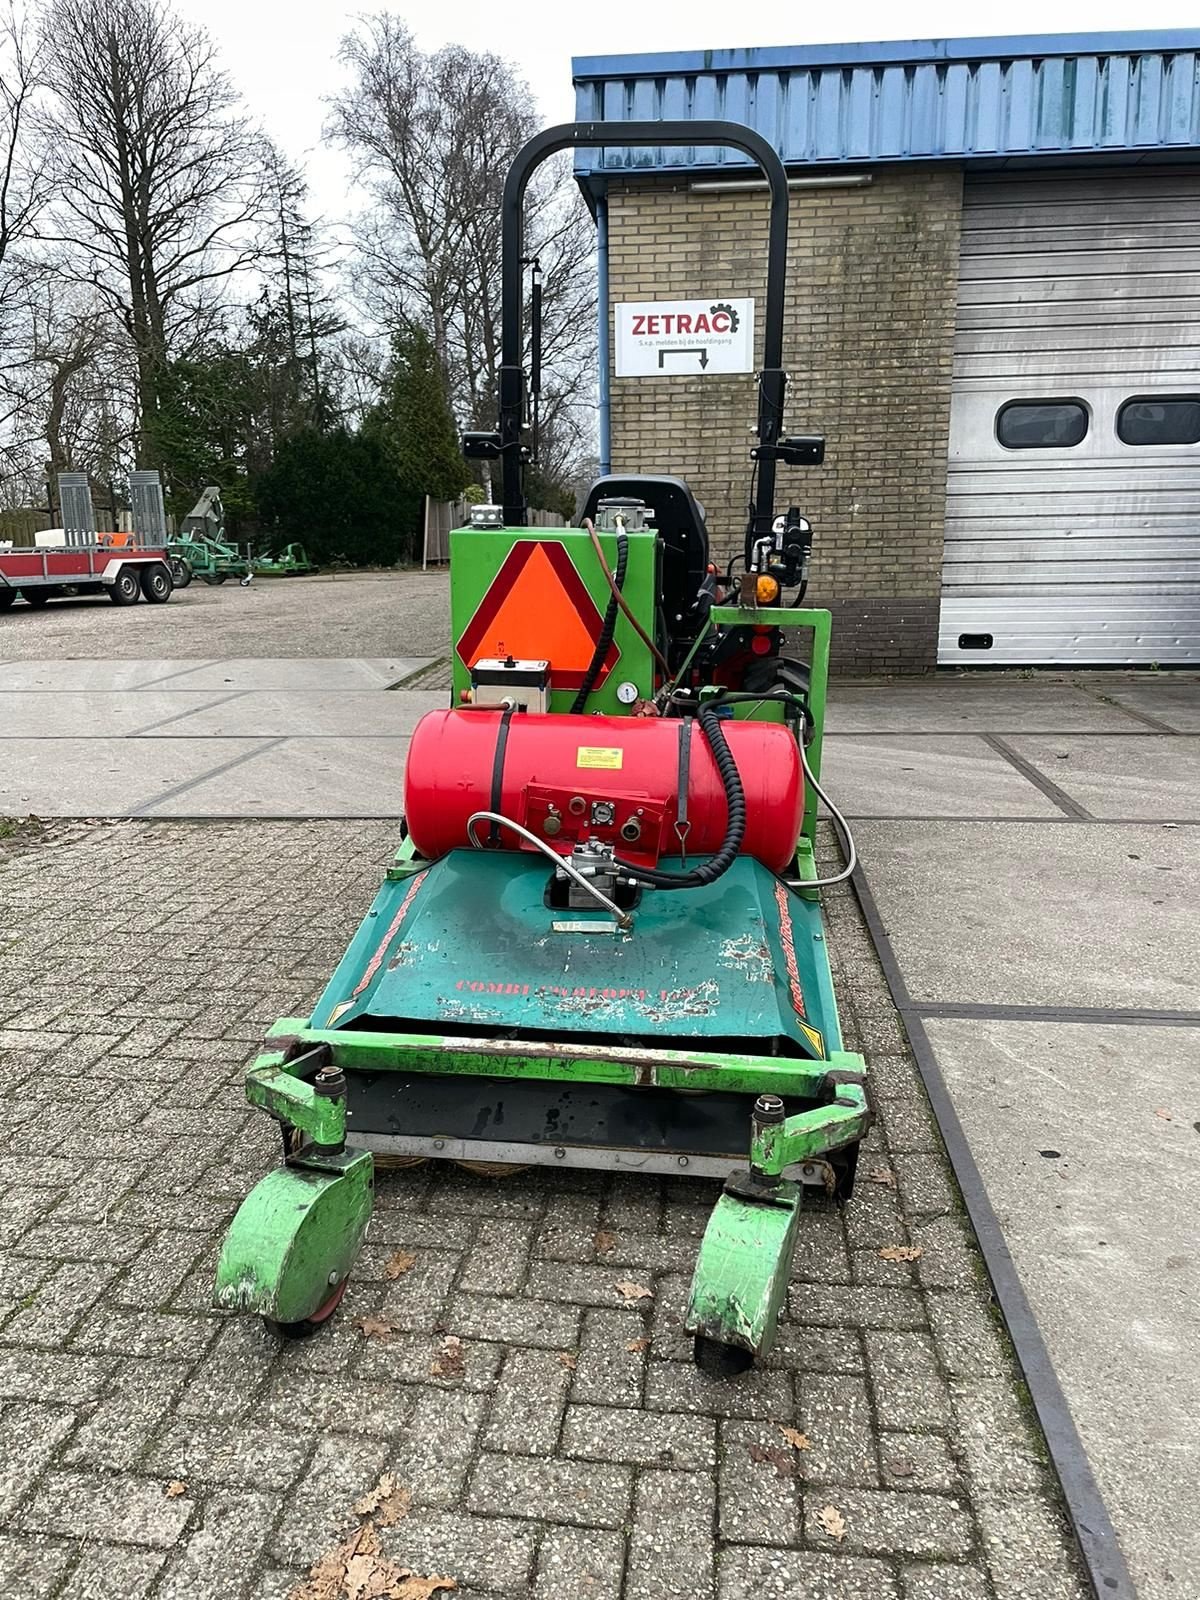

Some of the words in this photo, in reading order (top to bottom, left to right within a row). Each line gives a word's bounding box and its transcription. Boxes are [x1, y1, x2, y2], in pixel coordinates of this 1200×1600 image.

[632, 313, 730, 335] ZETRAC
[679, 339, 687, 347] bij
[696, 338, 732, 346] hoofdingang
[455, 979, 529, 995] COMBI
